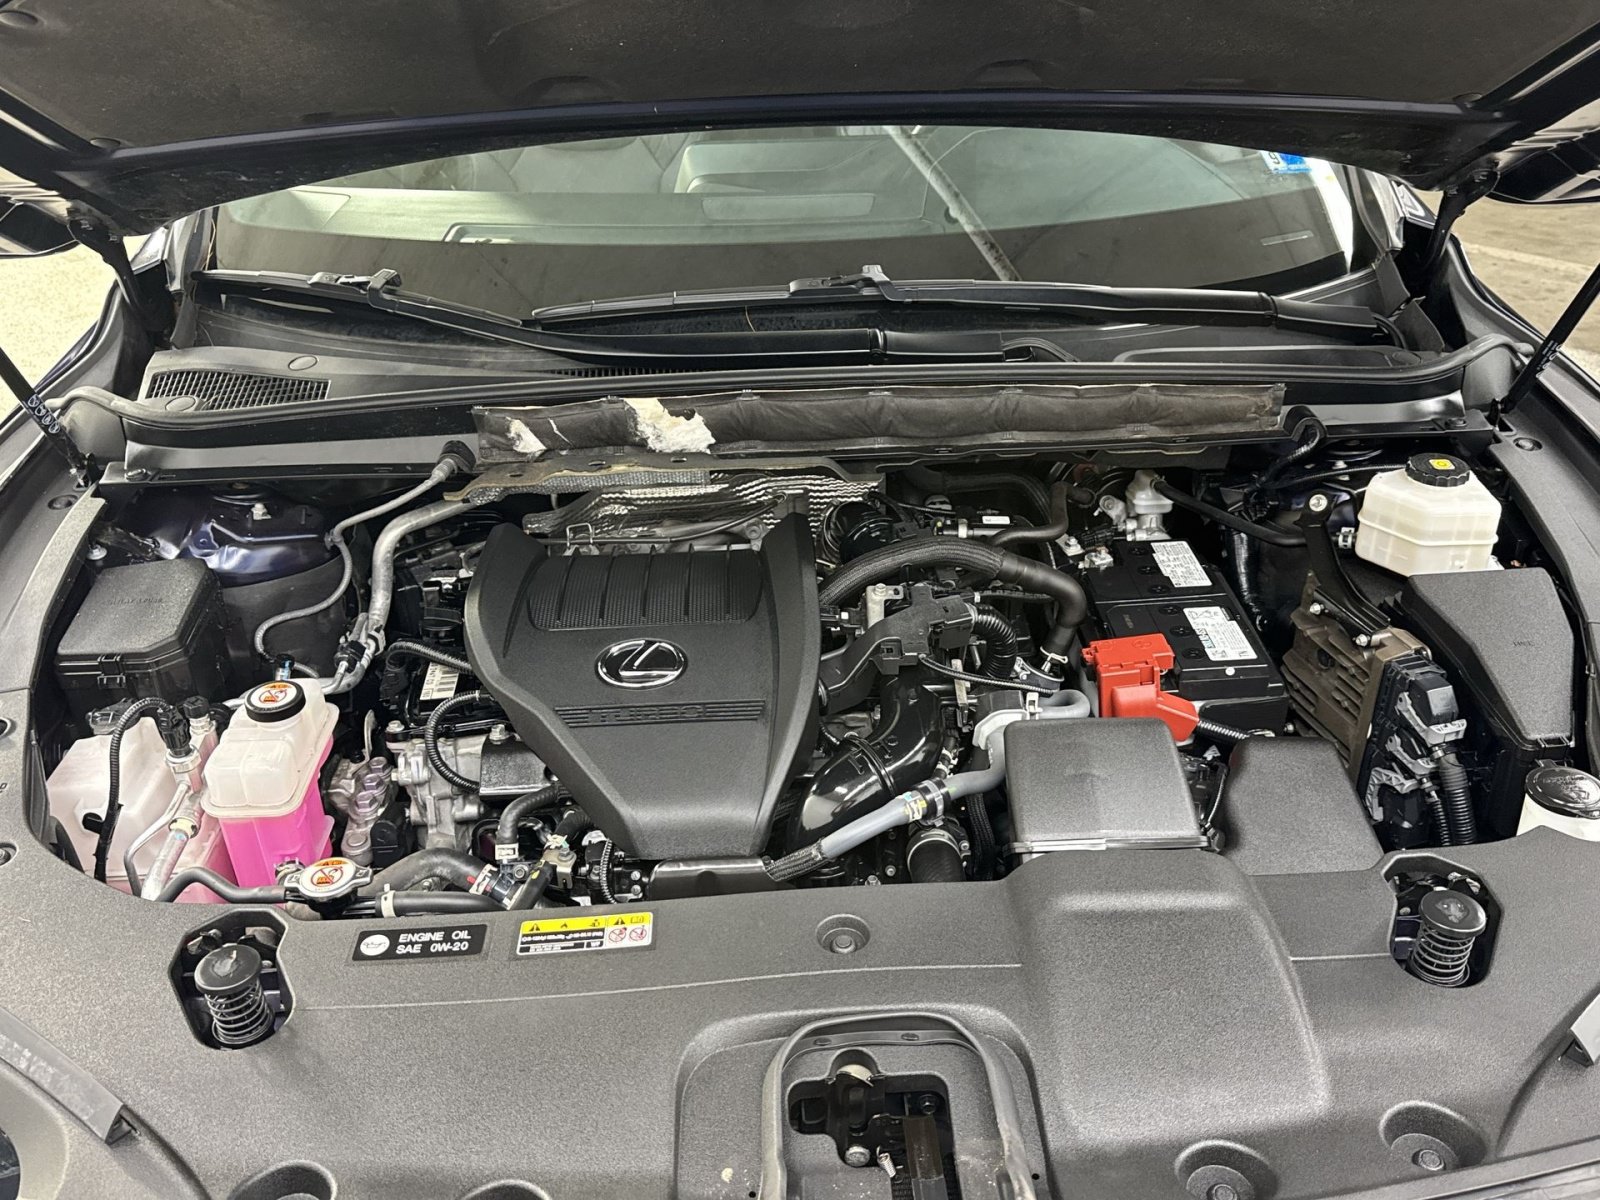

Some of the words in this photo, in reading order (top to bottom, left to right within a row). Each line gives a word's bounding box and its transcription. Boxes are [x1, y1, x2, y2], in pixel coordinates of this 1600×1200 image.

[591, 705, 704, 722] TURBO
[398, 931, 445, 943] ENGINE
[451, 930, 471, 940] OIL
[395, 943, 422, 954] SAE
[430, 941, 469, 953] 0W-20
